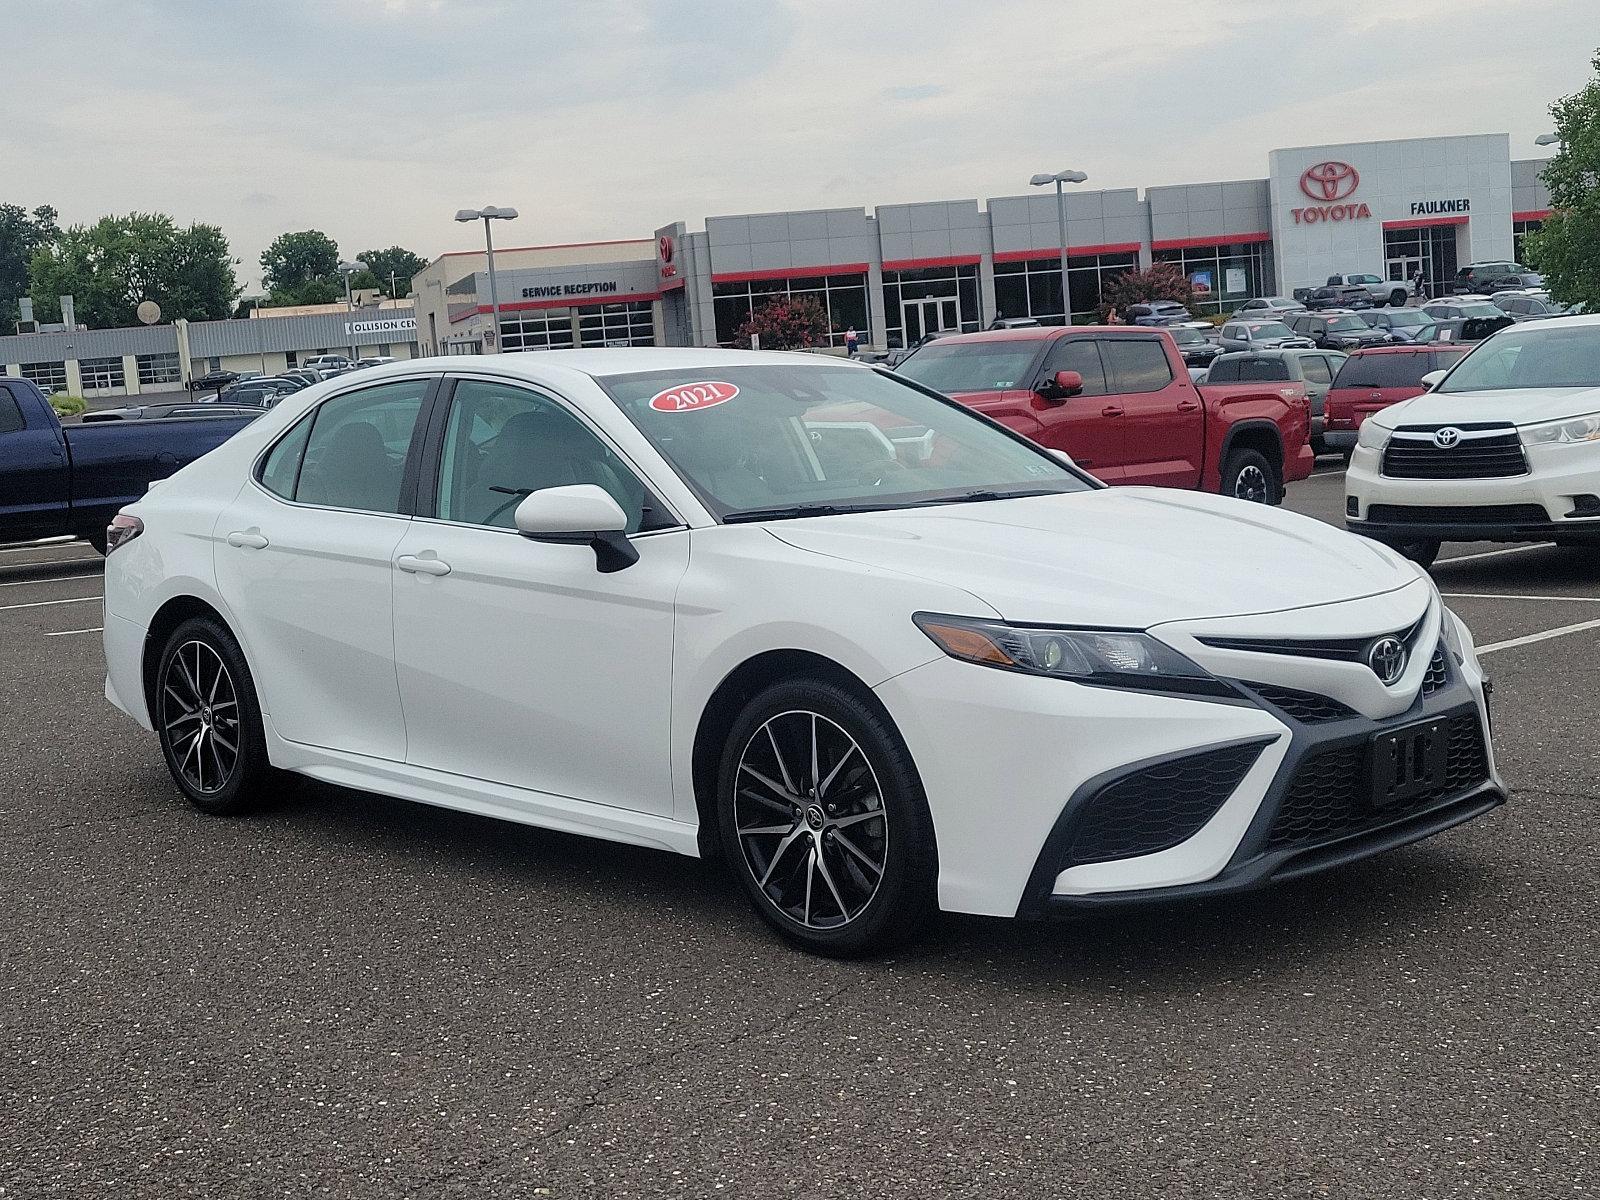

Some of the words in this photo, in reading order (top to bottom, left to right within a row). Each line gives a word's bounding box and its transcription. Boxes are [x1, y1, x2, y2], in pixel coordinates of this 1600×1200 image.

[1291, 203, 1371, 224] TOYOTA
[1411, 199, 1470, 215] FAULKNER
[522, 285, 561, 298] SERVICE
[564, 282, 617, 295] RECEPTION
[666, 383, 726, 410] 2021
